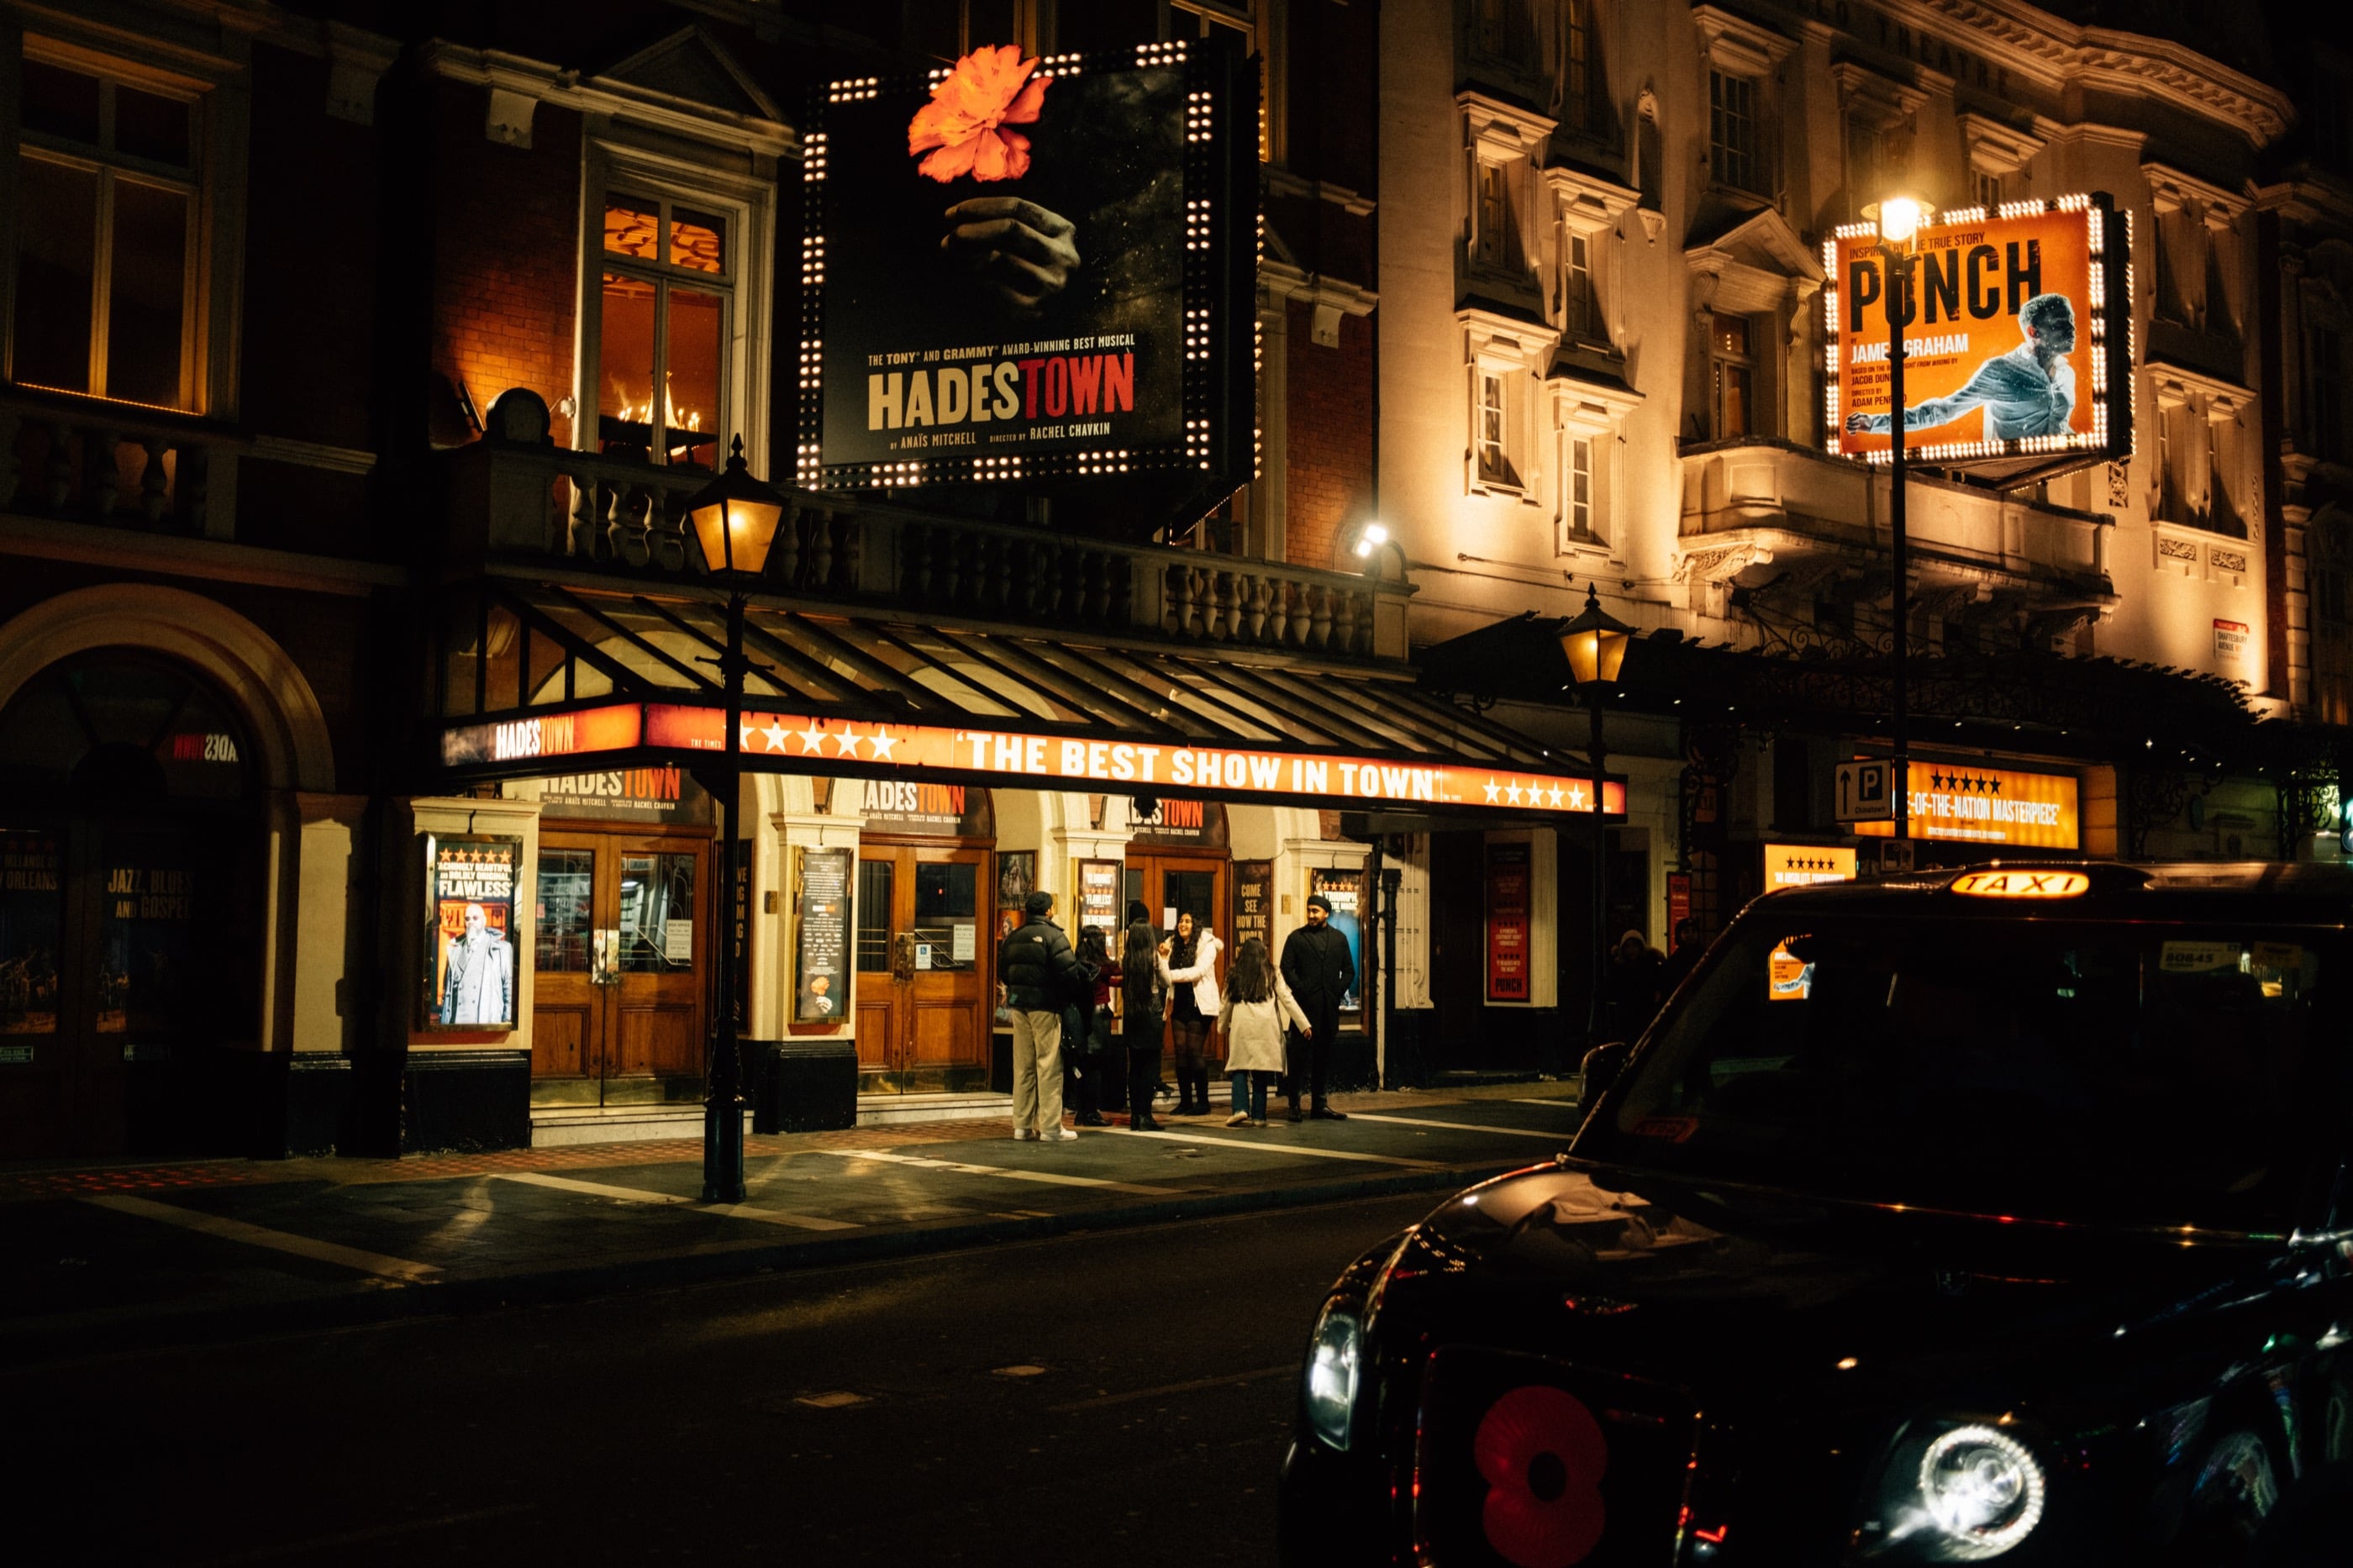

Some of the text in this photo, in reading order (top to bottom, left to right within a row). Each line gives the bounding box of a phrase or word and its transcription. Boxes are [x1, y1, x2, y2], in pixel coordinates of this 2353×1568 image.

[1928, 235, 1952, 250] TRUE
[1954, 231, 1985, 246] STORY
[1850, 239, 2041, 332] PUNCH
[868, 355, 883, 366] THE
[924, 350, 940, 362] AND
[1002, 339, 1071, 357] AWARD-WINNING
[1073, 336, 1095, 350] BEST
[1098, 334, 1135, 348] MUSICAL
[1850, 334, 1969, 364] JAME GRAHAM
[1917, 360, 1931, 368] FROM
[1931, 358, 1950, 366] WRONG
[1851, 375, 1873, 386] JACOB
[868, 353, 1134, 431] HADESTOWN
[1851, 388, 1875, 397] DIRECTED
[1851, 397, 1873, 408] ADAM
[901, 433, 928, 449] ANAÏS
[932, 432, 976, 447] MITCHELL
[989, 434, 1017, 444] DIRECTED
[1019, 433, 1026, 441] BY
[1030, 424, 1066, 440] RACHEL
[1069, 422, 1110, 438] CHAVKIN
[495, 715, 575, 760] HADESTOWN
[691, 739, 722, 749] THE TIMES
[1061, 739, 1161, 781] BEST
[1171, 750, 1282, 791] SHOW
[1292, 758, 1328, 793] IN
[1863, 769, 1878, 798] P
[1854, 805, 1886, 814] Chinatown
[6, 870, 59, 892] ORLEANS
[150, 869, 194, 894] BLUES
[1241, 884, 1262, 897] COME
[1965, 876, 2076, 892] TAXI
[115, 895, 191, 920] AND GOSPEL
[1245, 899, 1258, 913] SEE
[1236, 914, 1266, 929] HOW THE
[1495, 978, 1523, 992] PUNCH
